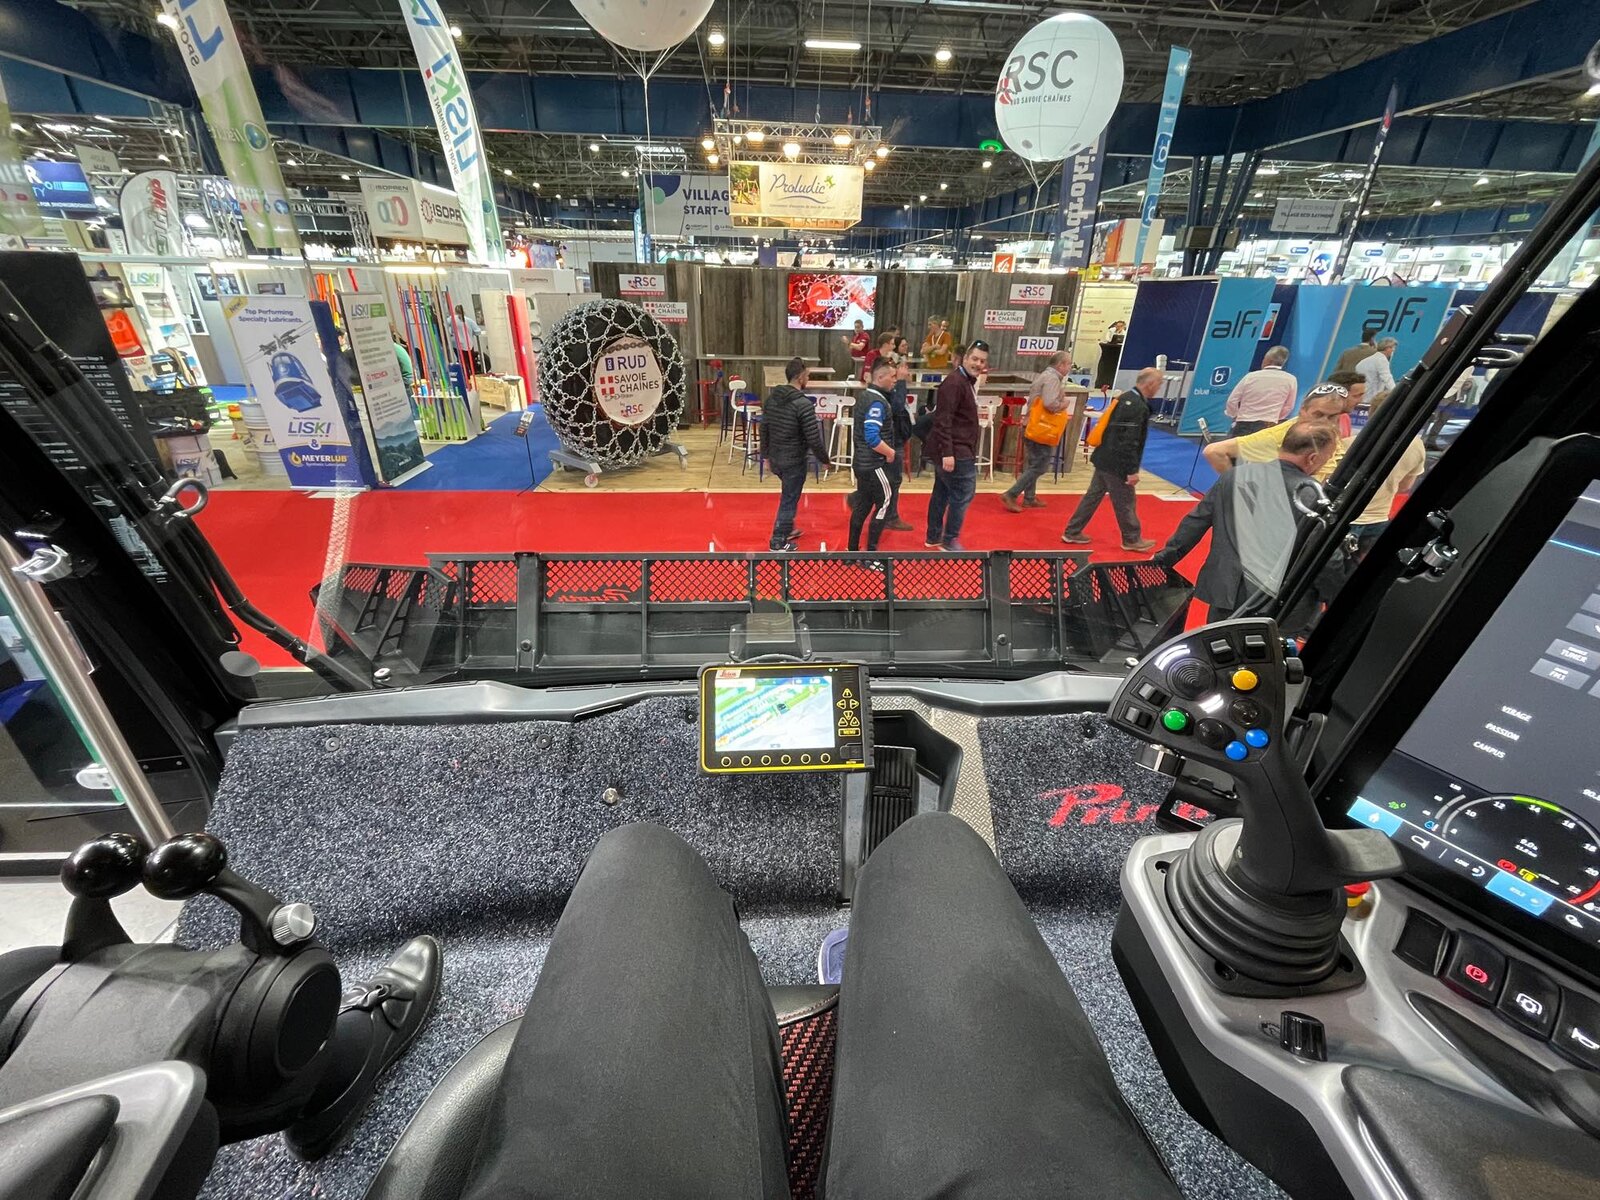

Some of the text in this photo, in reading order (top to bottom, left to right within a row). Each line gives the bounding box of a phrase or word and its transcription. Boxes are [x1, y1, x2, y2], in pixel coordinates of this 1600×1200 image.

[1005, 50, 1078, 93] RSC
[1021, 96, 1041, 104] SAVOIE
[769, 174, 825, 194] Proludic
[683, 188, 729, 201] VILLAG
[432, 203, 463, 220] ISOPR
[684, 205, 729, 216] START-U
[130, 272, 159, 281] LISKI
[634, 276, 656, 287] RSC
[1025, 286, 1045, 296] RSC
[1029, 339, 1054, 350] RUD
[617, 355, 647, 370] RUD
[614, 372, 647, 384] SAVOIE
[619, 380, 660, 393] CHAINES
[626, 404, 644, 414] RSC
[287, 421, 331, 434] LISKI
[310, 439, 319, 448] &
[302, 454, 347, 462] MEYERLUB
[1485, 722, 1520, 741] PASSION
[1473, 741, 1506, 758] CAMPUS
[1493, 801, 1506, 810] 12
[1528, 804, 1541, 814] 14
[1464, 809, 1477, 818] 10
[1561, 819, 1576, 830] 16
[1582, 842, 1598, 853] 18
[1584, 867, 1599, 877] 20
[1566, 884, 1582, 895] 22
